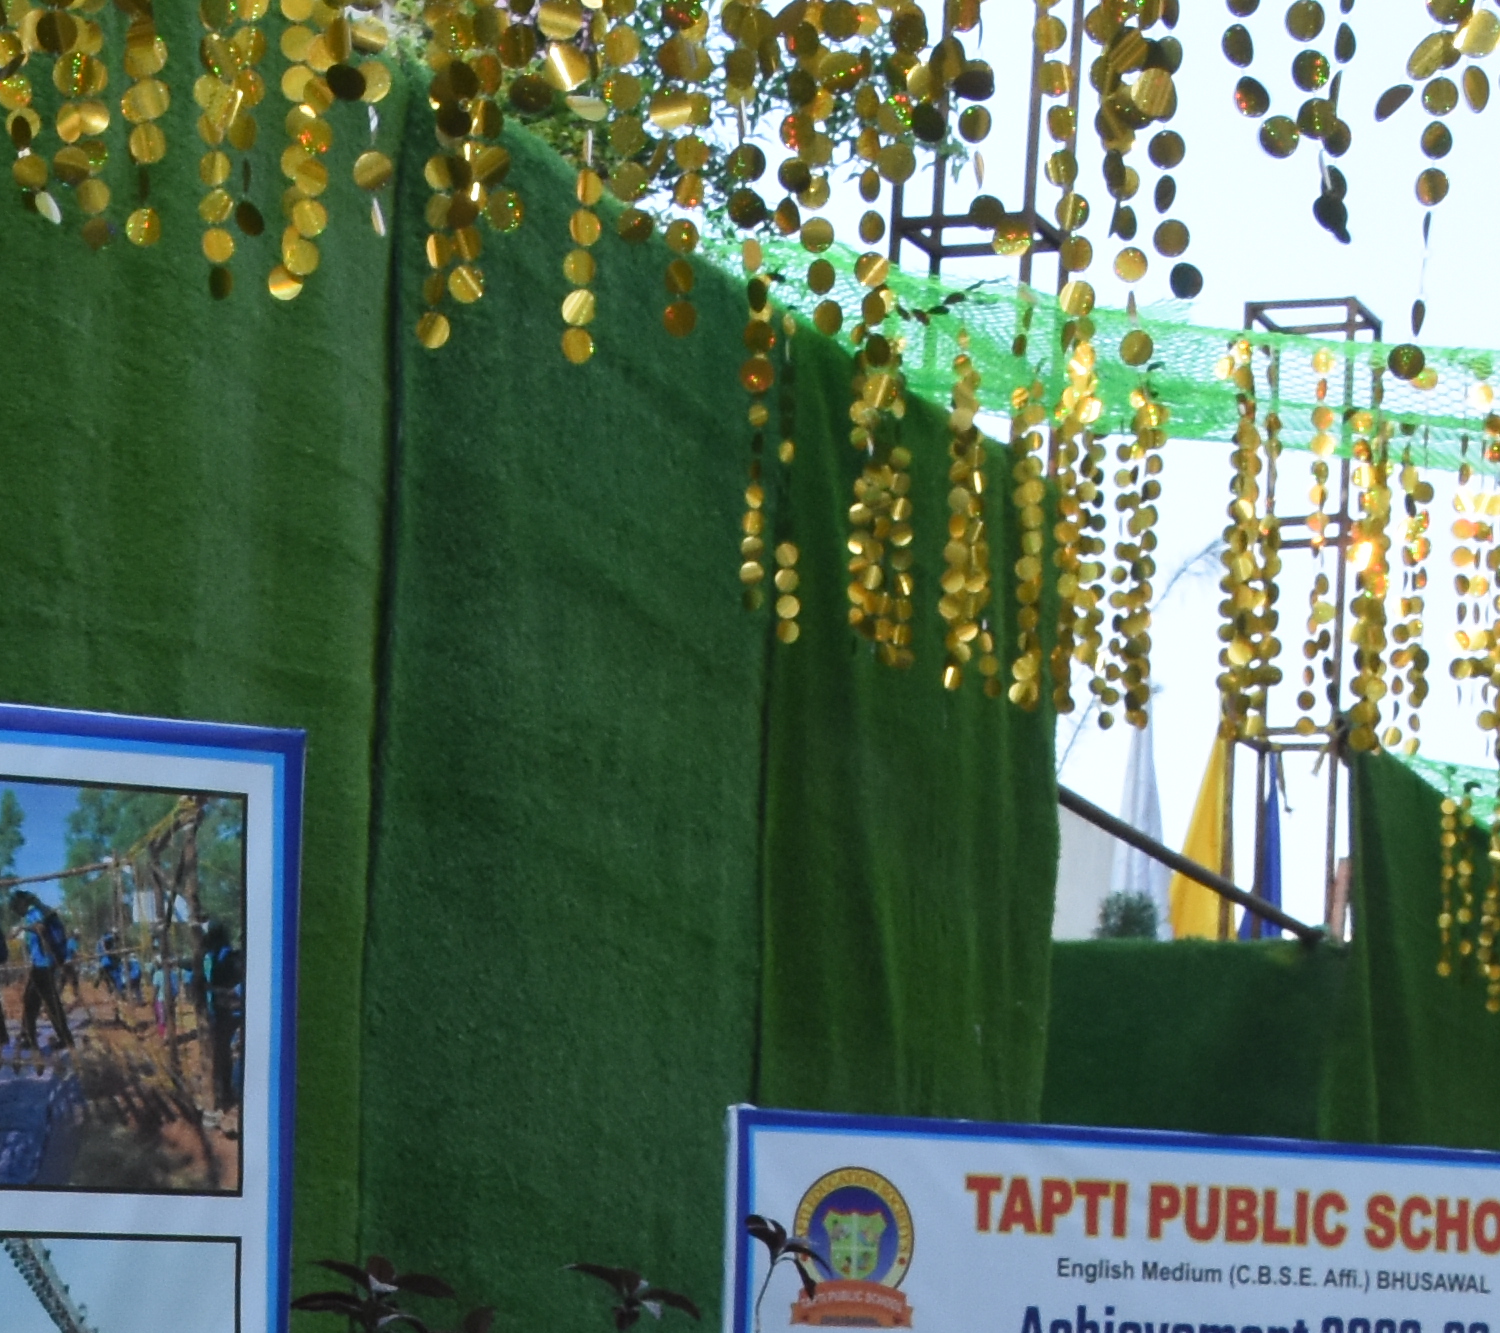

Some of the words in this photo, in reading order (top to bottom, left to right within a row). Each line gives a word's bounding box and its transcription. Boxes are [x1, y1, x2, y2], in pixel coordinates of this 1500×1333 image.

[965, 1172, 1129, 1239] TAPTI
[1147, 1182, 1348, 1248] PUBLIC
[1057, 1257, 1134, 1283] English
[1142, 1261, 1222, 1282] Medium
[1230, 1264, 1317, 1288] (C.B.S.E.
[1324, 1268, 1370, 1294] Affi.)
[1377, 1270, 1491, 1294] BHUSAWAL
